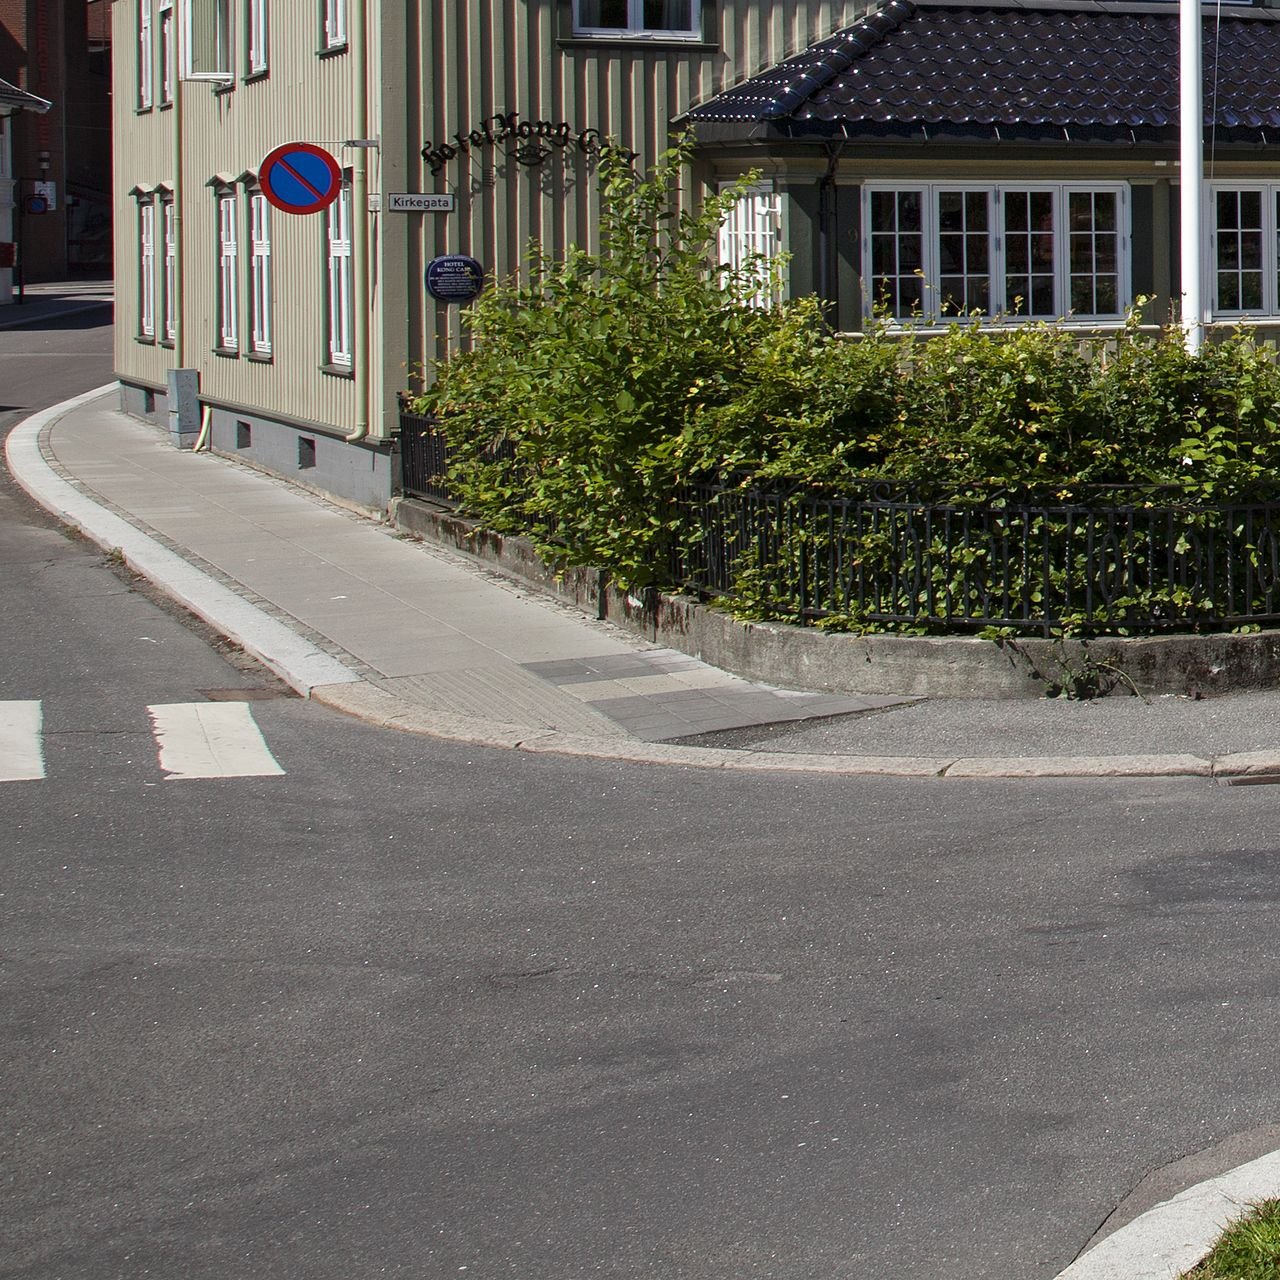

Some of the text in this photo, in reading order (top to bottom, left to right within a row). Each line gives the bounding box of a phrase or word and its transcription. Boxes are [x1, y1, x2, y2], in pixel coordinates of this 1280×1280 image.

[421, 117, 495, 177] Hotel
[490, 112, 571, 148] Kong
[393, 197, 449, 210] Kirkegata
